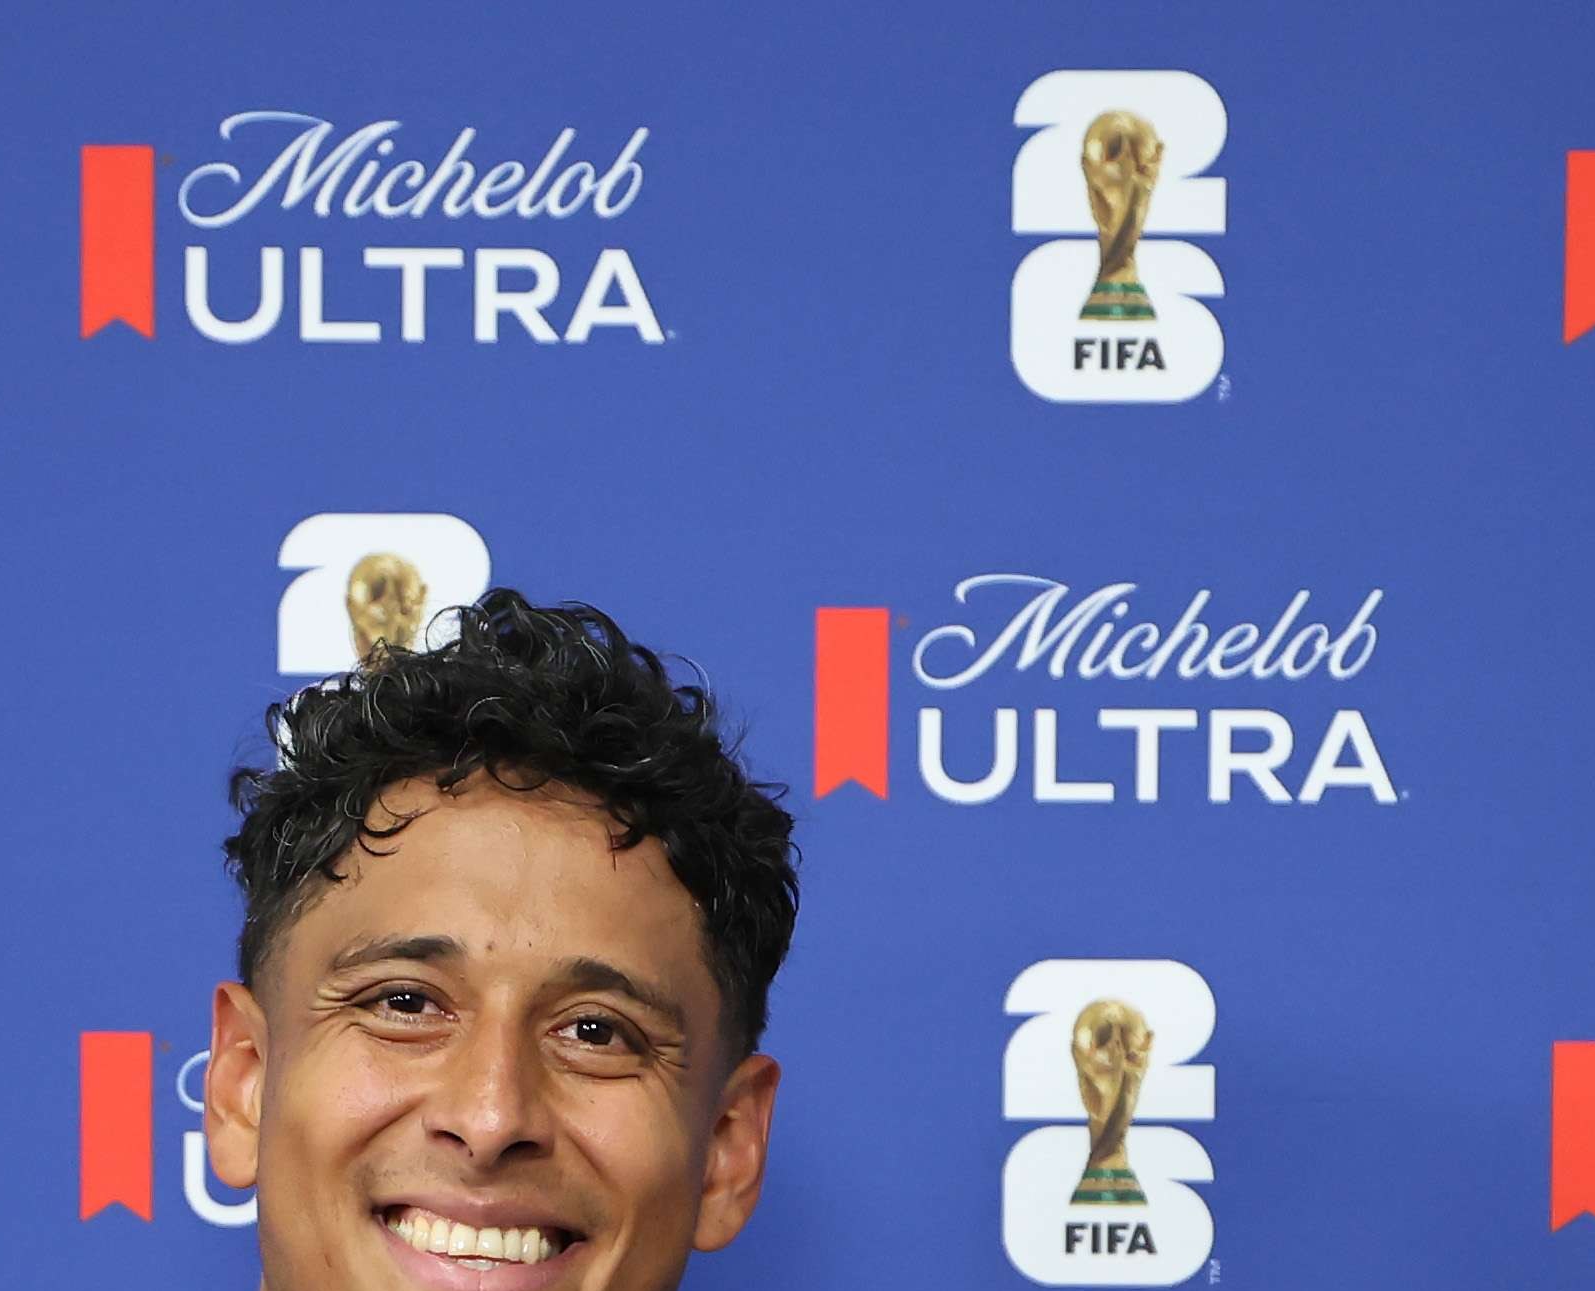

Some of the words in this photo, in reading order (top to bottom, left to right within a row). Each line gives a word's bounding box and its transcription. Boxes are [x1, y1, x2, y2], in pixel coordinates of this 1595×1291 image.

[179, 112, 648, 227] Michelob
[185, 247, 664, 344] ULTRA
[1074, 338, 1165, 370] FIFA
[913, 574, 1382, 689] Michelob
[919, 708, 1397, 804] ULTRA
[1065, 1223, 1156, 1254] FIFA
